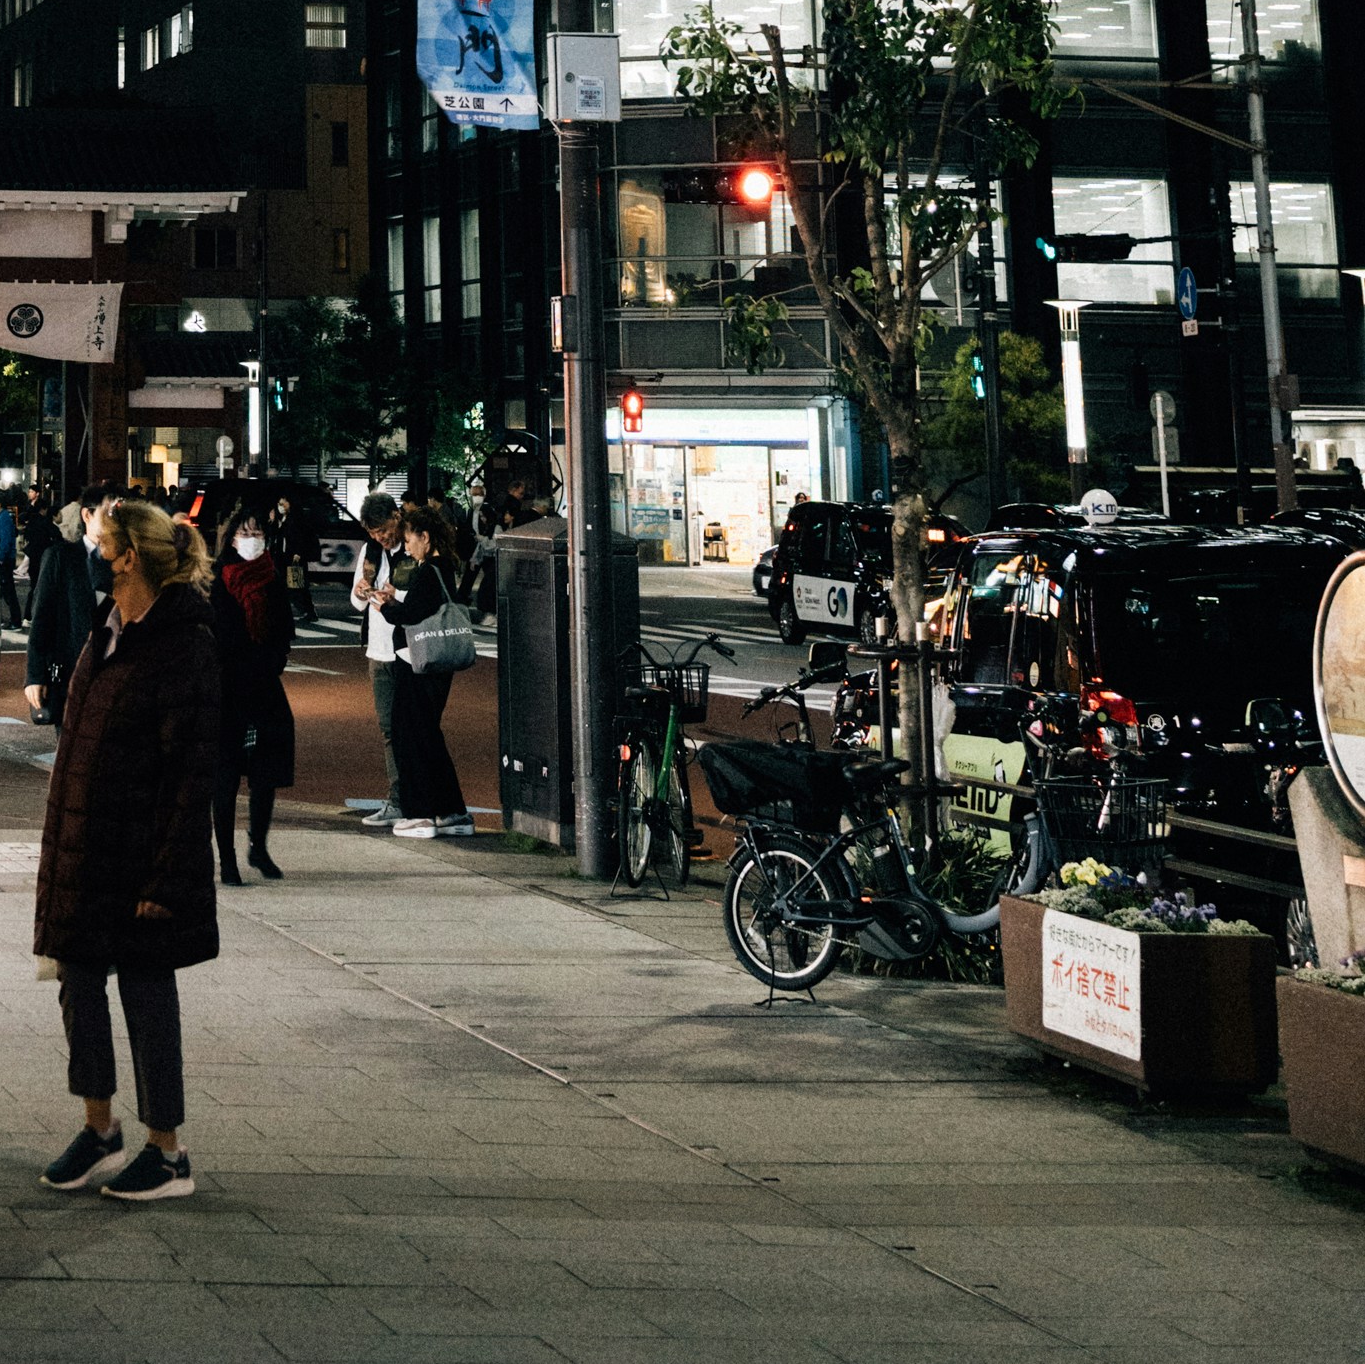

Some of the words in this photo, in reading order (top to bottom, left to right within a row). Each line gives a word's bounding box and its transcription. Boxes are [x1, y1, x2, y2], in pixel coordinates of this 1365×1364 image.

[444, 96, 485, 110] 芝公園
[827, 586, 848, 619] GO
[414, 630, 436, 642] DEAN
[1051, 950, 1131, 1012] ポイ捨て禁止
